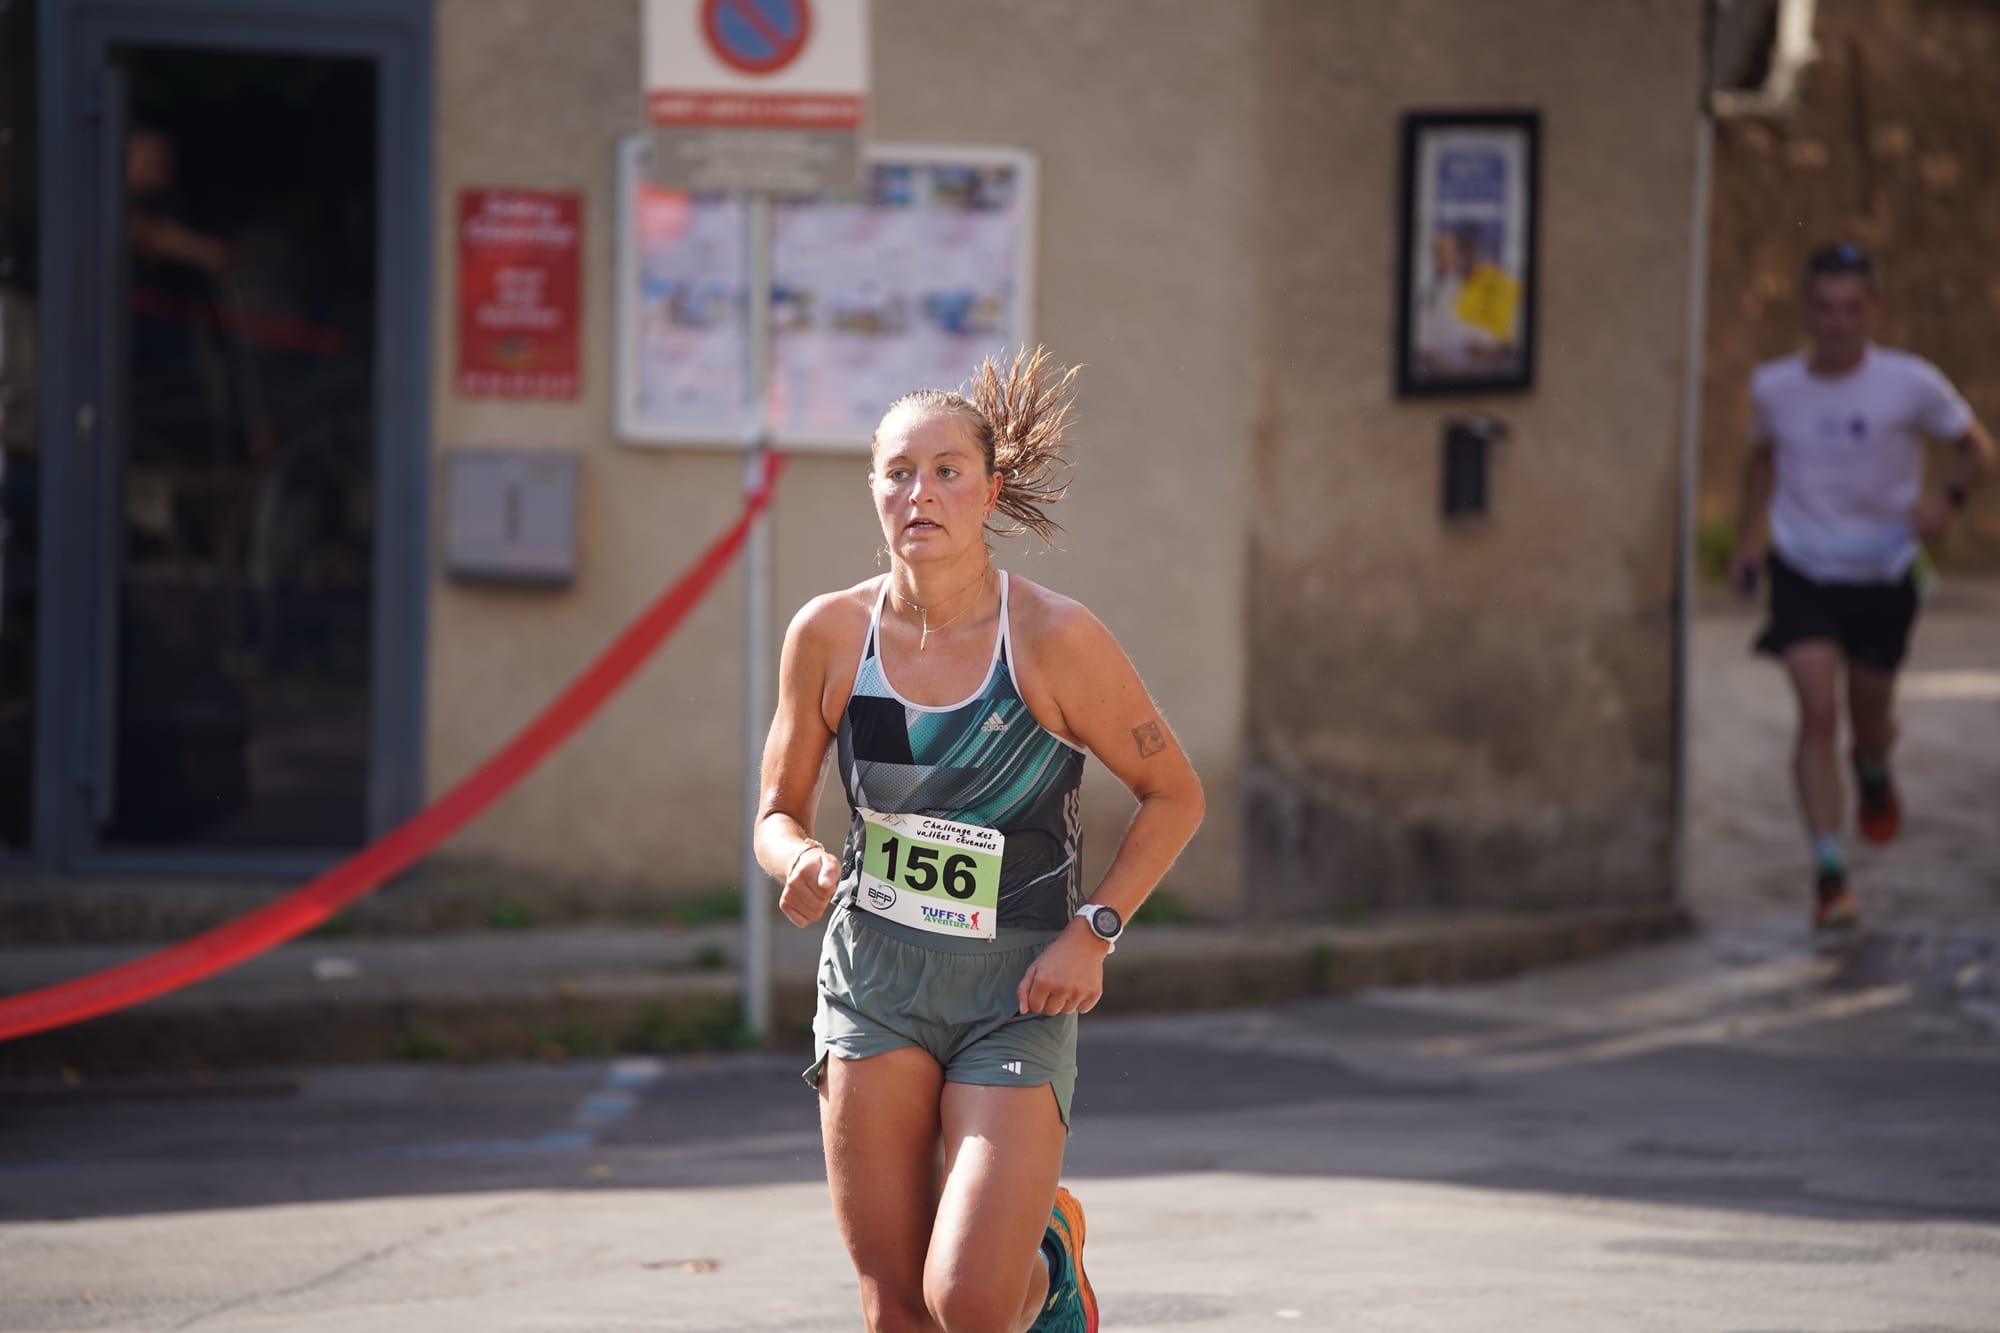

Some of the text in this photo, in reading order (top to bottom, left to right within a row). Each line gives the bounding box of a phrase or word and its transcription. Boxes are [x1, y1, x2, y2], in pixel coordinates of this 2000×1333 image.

[916, 829, 997, 850] vallées cévenoles
[922, 820, 993, 840] Challenge des
[881, 836, 977, 899] 156
[868, 887, 893, 903] BFP
[920, 905, 966, 923] TUFF'S
[923, 914, 971, 929] Aventure
